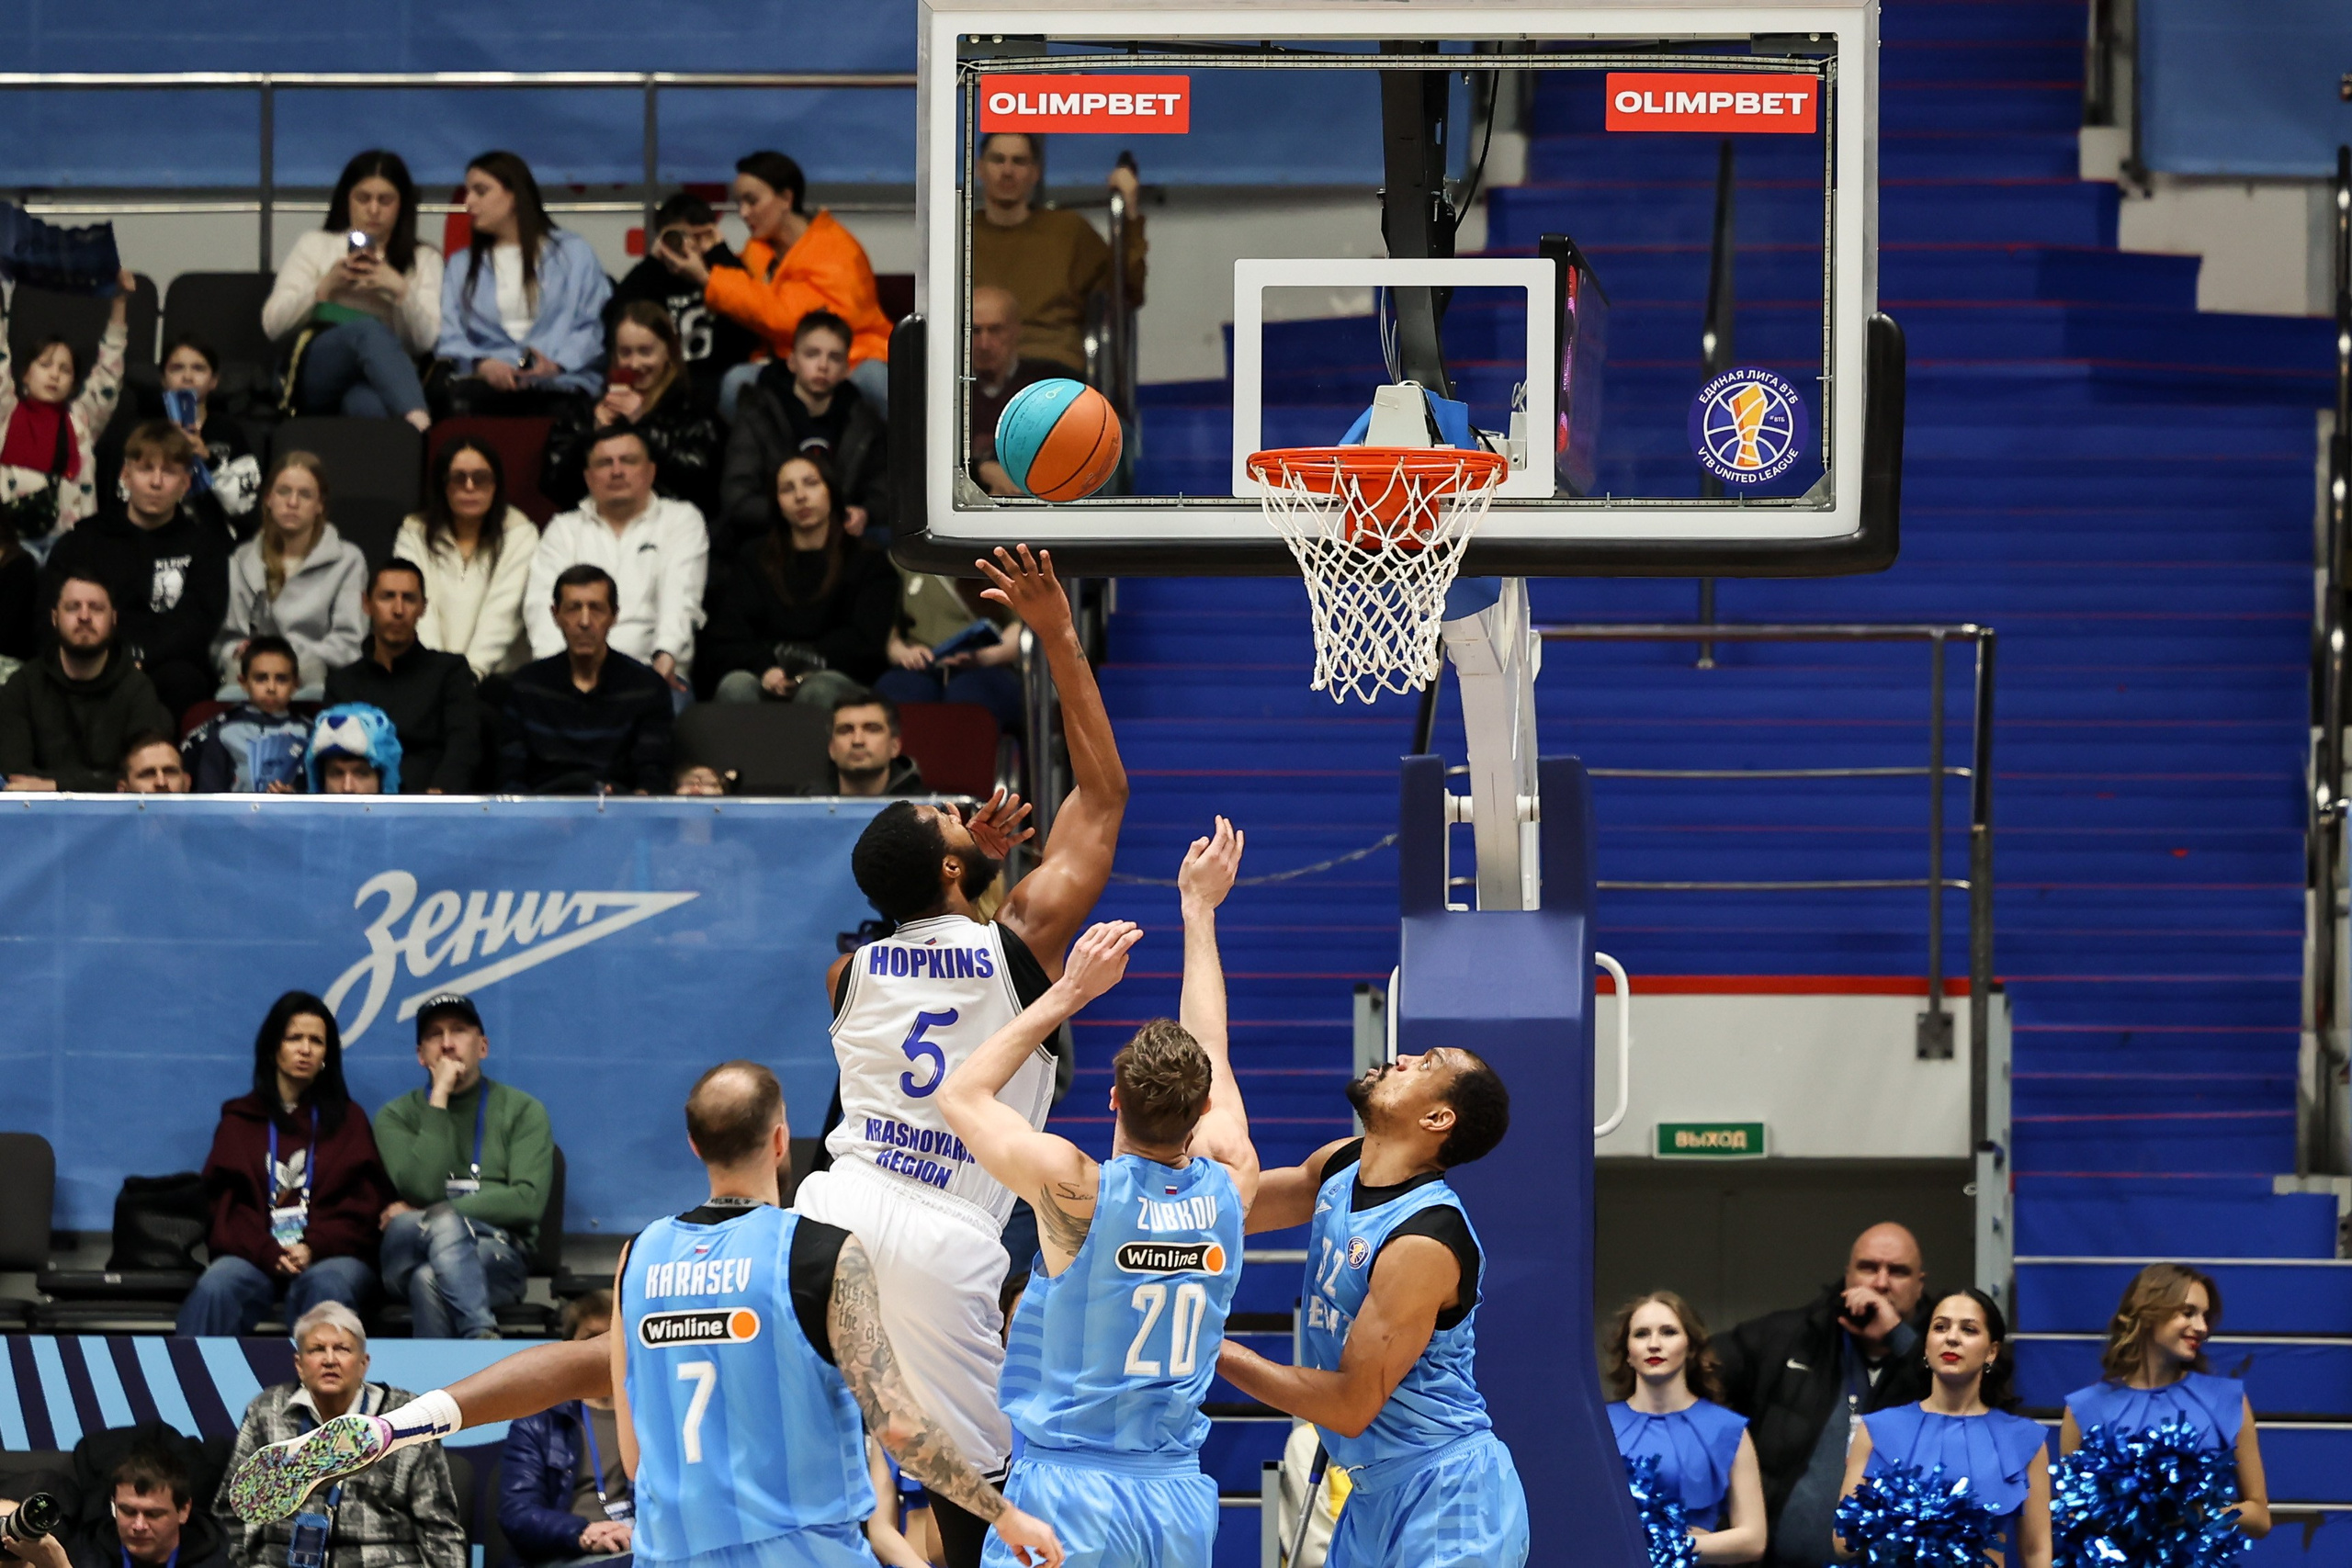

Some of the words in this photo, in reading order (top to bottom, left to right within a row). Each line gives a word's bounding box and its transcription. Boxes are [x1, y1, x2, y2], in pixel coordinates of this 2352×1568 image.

[989, 92, 1182, 116] OLIMPBET
[1614, 90, 1809, 115] OLIMPBET
[1698, 370, 1745, 404] ЕДИНАЯ
[1747, 369, 1779, 387] ЛИГА
[1779, 383, 1799, 404] ВТБ
[1698, 446, 1716, 468] VTB
[1714, 465, 1757, 483] UNITED
[1758, 447, 1799, 481] LEAGUE
[869, 946, 994, 979] HOPKINS
[899, 1008, 959, 1098] 5
[1675, 1130, 1747, 1150] ВЫХОД
[876, 1149, 953, 1190] REGION
[1136, 1195, 1217, 1231] ZUBKOV
[1127, 1247, 1198, 1268] Winline
[645, 1258, 752, 1300] KARASEV
[646, 1317, 723, 1340] Winline
[1124, 1283, 1207, 1378] 20
[676, 1361, 717, 1464] 7
